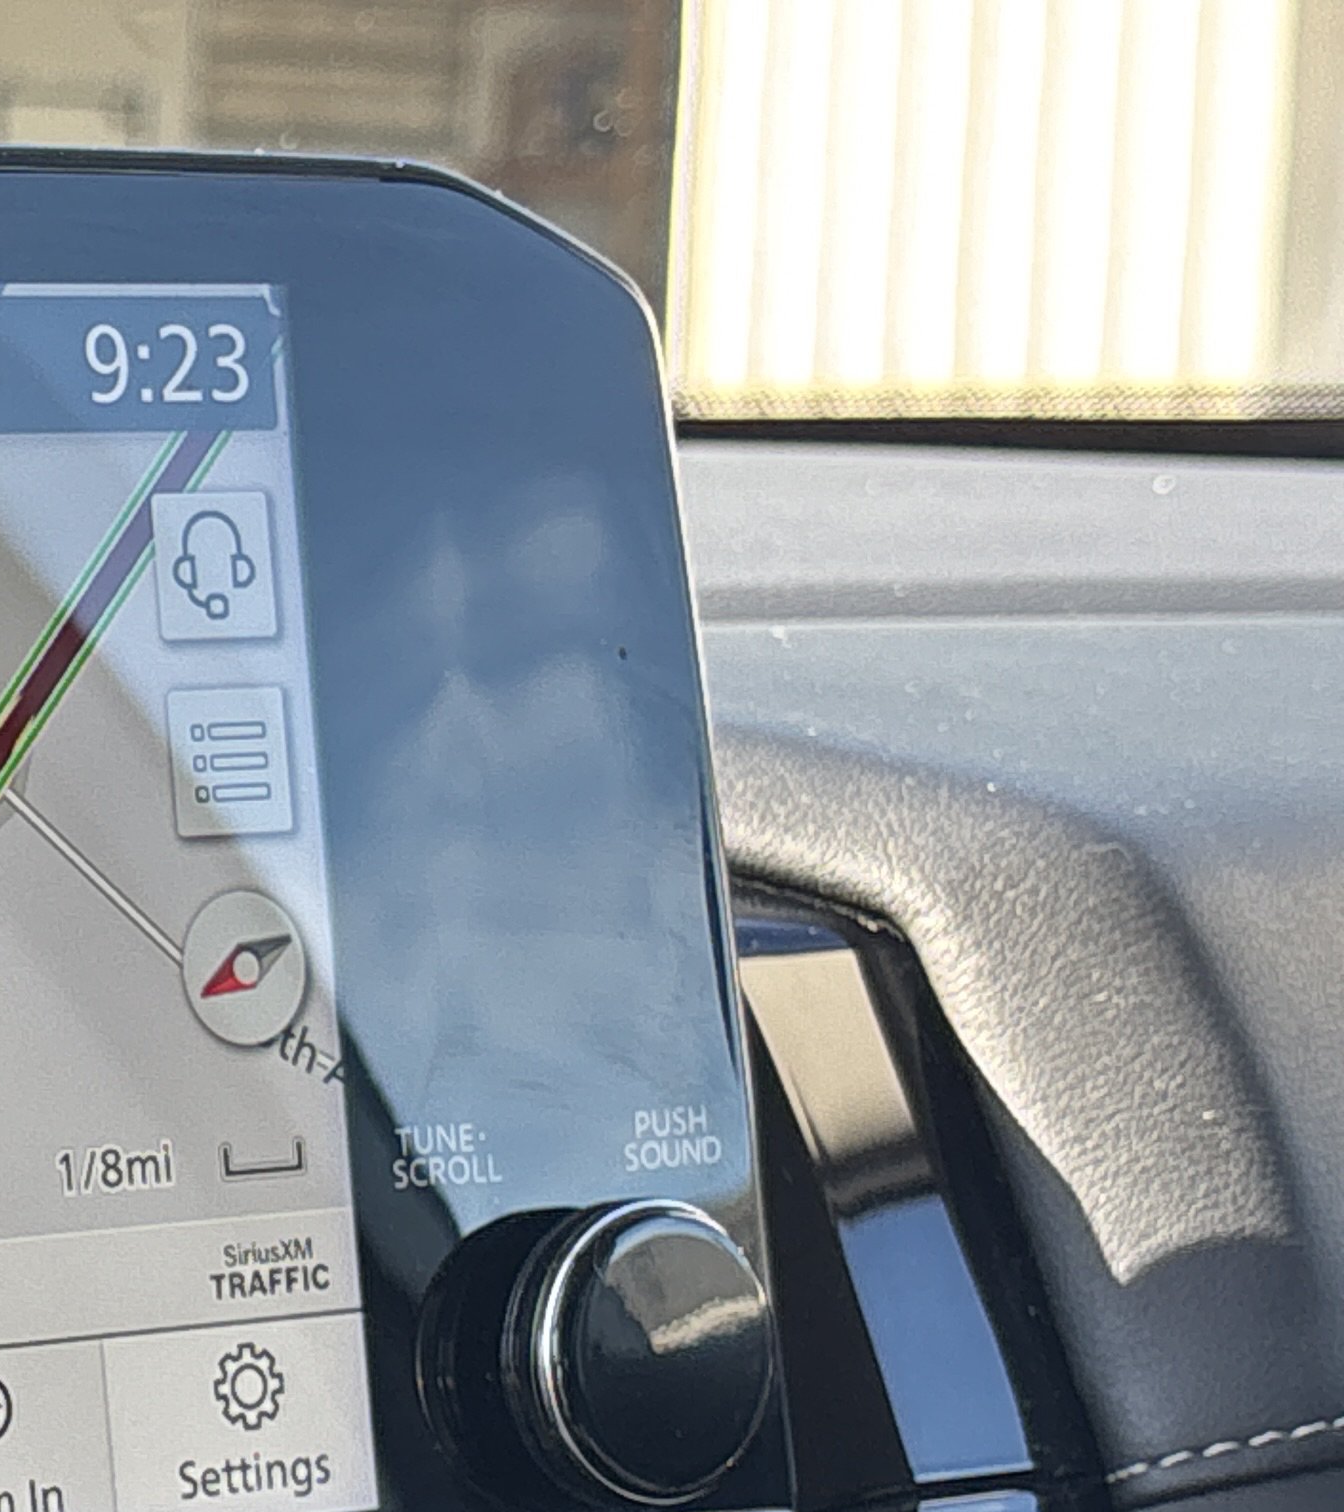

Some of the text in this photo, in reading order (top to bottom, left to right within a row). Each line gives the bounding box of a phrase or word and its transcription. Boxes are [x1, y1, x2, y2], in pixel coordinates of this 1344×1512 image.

[85, 323, 250, 404] 9:23
[633, 1106, 710, 1139] PUSH
[56, 1141, 175, 1196] 1/8mi
[392, 1152, 504, 1189] SCROLL
[624, 1135, 722, 1172] SOUND
[222, 1236, 314, 1268] SiriusXM
[209, 1264, 330, 1301] TRAFFIC
[178, 1451, 332, 1502] Settings
